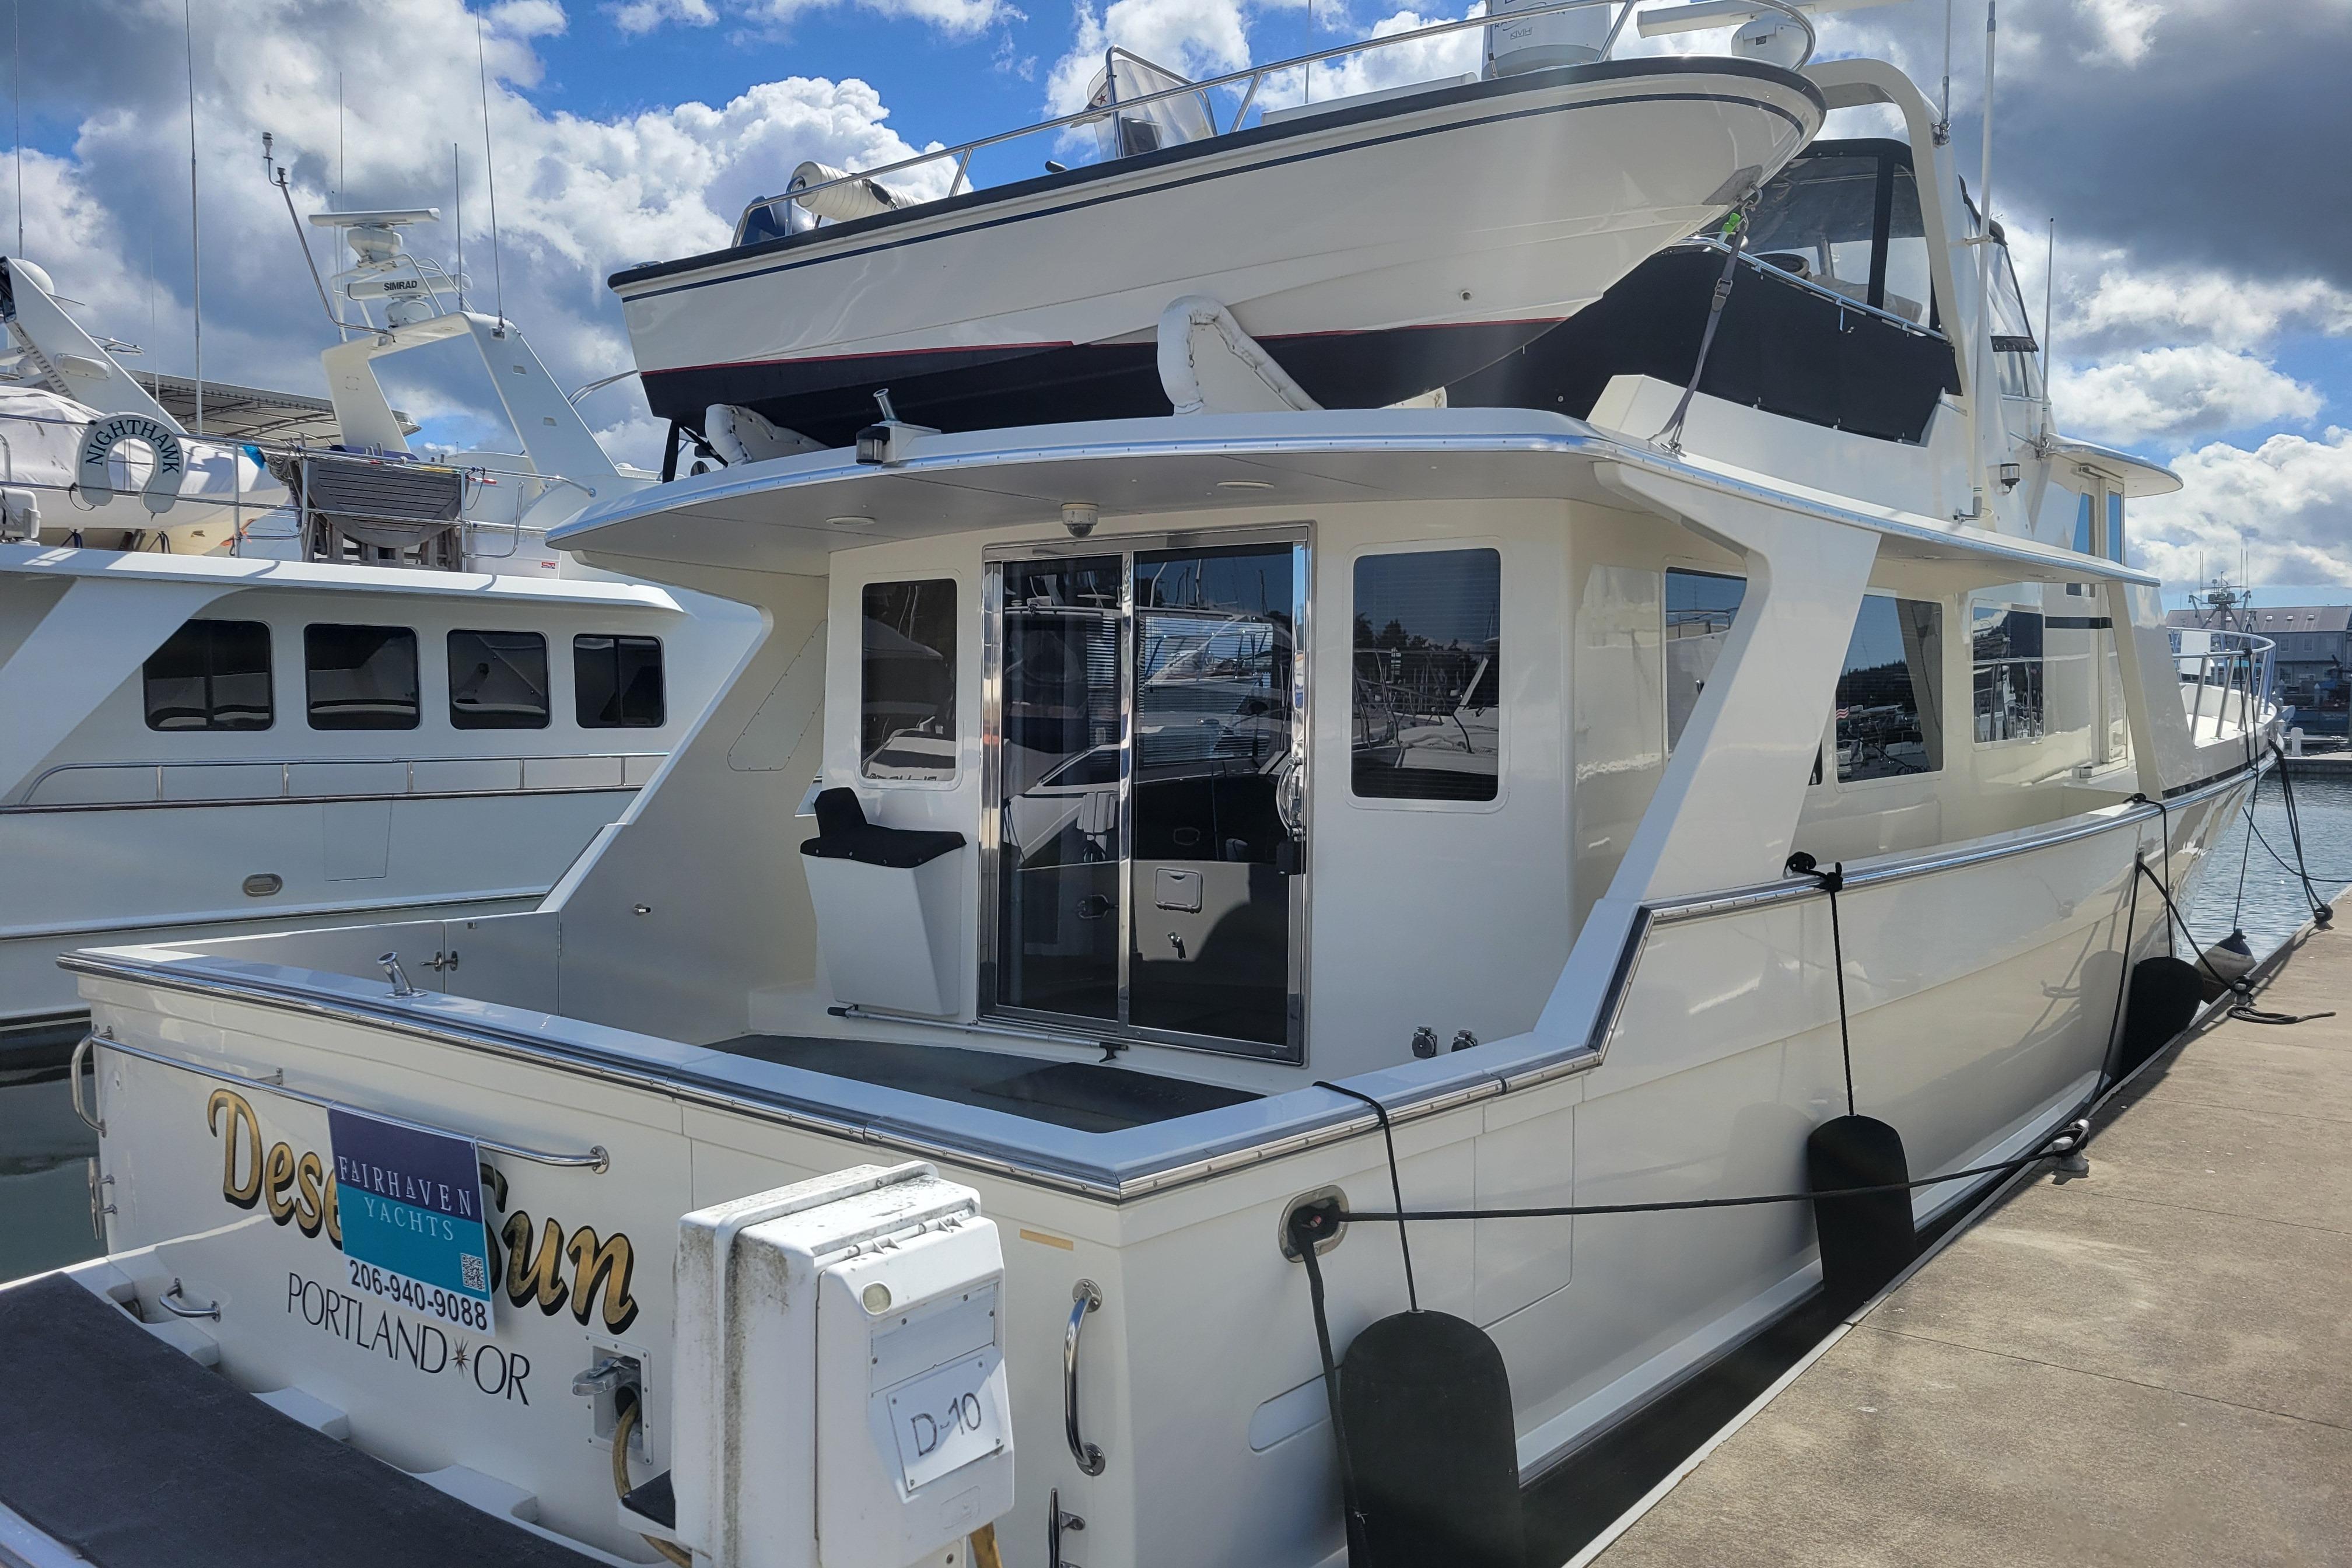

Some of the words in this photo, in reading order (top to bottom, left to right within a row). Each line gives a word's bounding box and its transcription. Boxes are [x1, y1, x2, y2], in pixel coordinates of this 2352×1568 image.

[1510, 27, 1533, 40] KVH
[384, 280, 417, 290] SIMRAD
[85, 419, 180, 474] NIGHTHAWK
[337, 1155, 473, 1216] FAIRHAVEN
[363, 1196, 454, 1241] YACHTS
[349, 1259, 488, 1331] 206-940-9088
[288, 1272, 447, 1374] PORTLAND
[474, 1345, 530, 1406] OR
[910, 1392, 982, 1457] D-10
